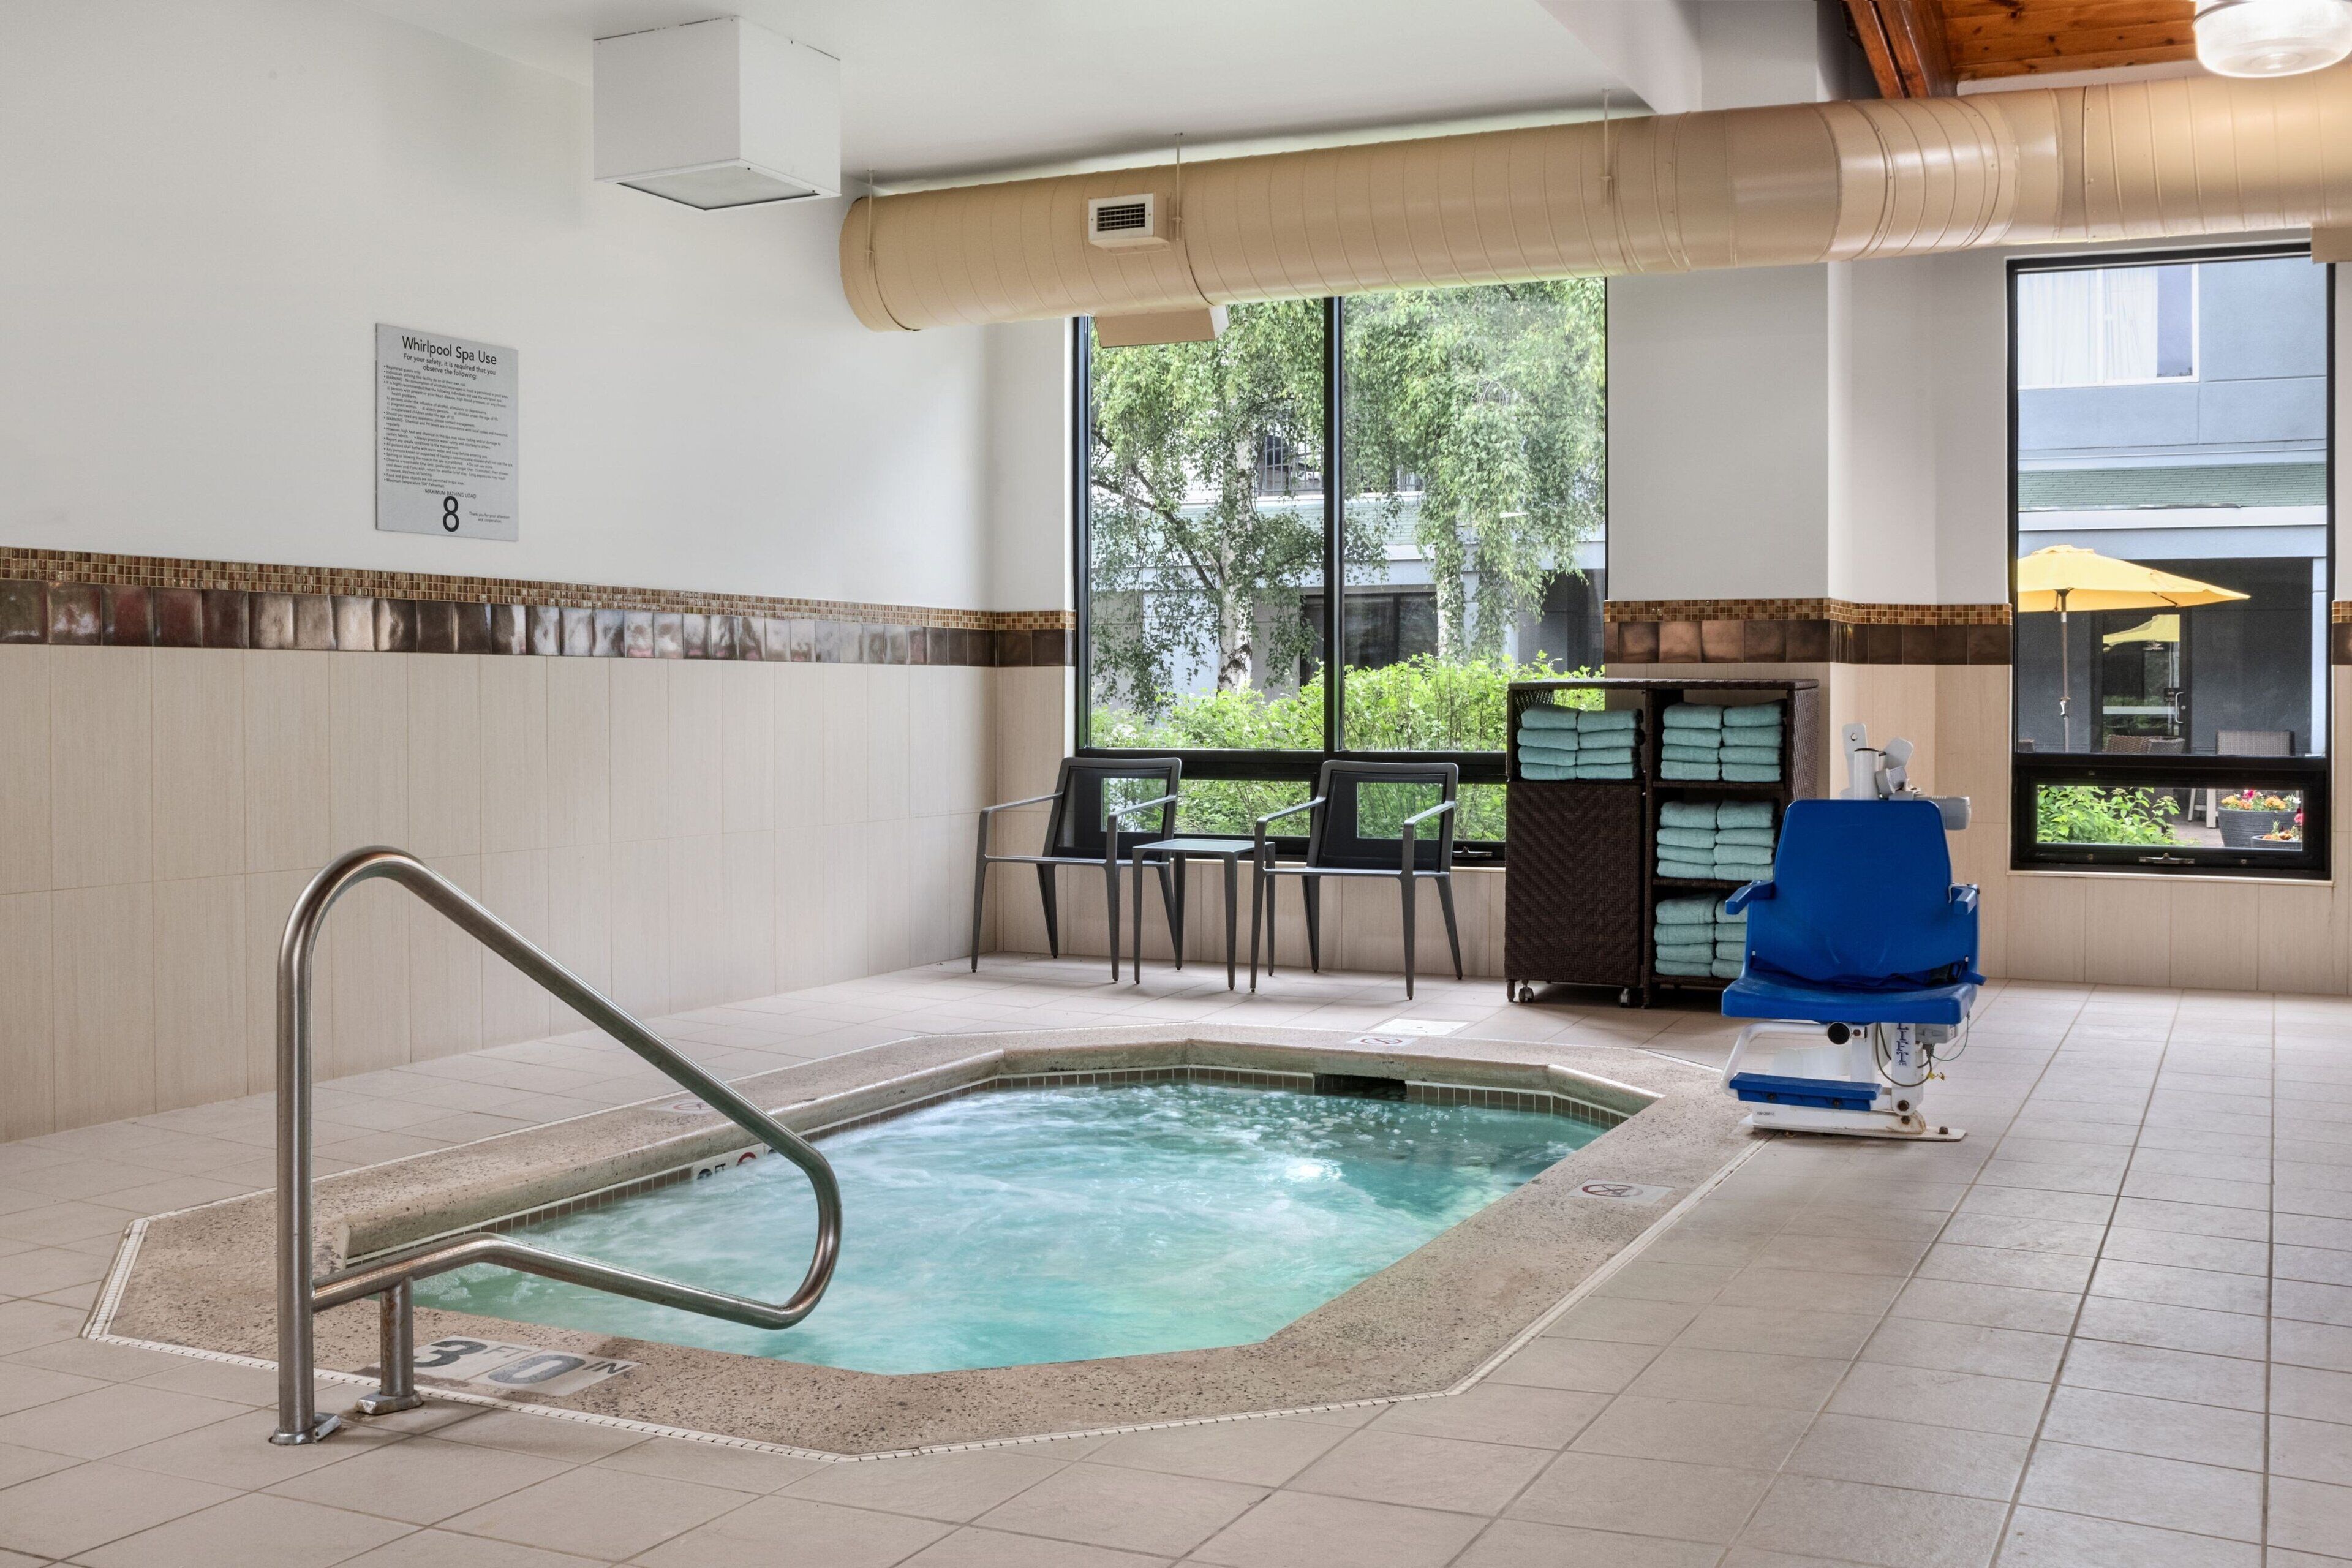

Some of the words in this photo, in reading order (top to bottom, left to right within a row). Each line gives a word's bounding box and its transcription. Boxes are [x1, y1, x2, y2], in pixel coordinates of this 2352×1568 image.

[402, 335, 452, 358] Whirlpool
[456, 345, 474, 363] Spa
[478, 350, 497, 365] Use
[423, 364, 442, 373] observe
[454, 370, 477, 380] following:
[426, 357, 442, 368] safety,
[454, 363, 475, 372] required
[442, 495, 459, 532] 8
[1896, 1023, 1909, 1062] LIFT
[413, 1340, 488, 1368] 3
[481, 1346, 531, 1359] FT
[488, 1354, 586, 1384] 0
[583, 1359, 633, 1375] IN
